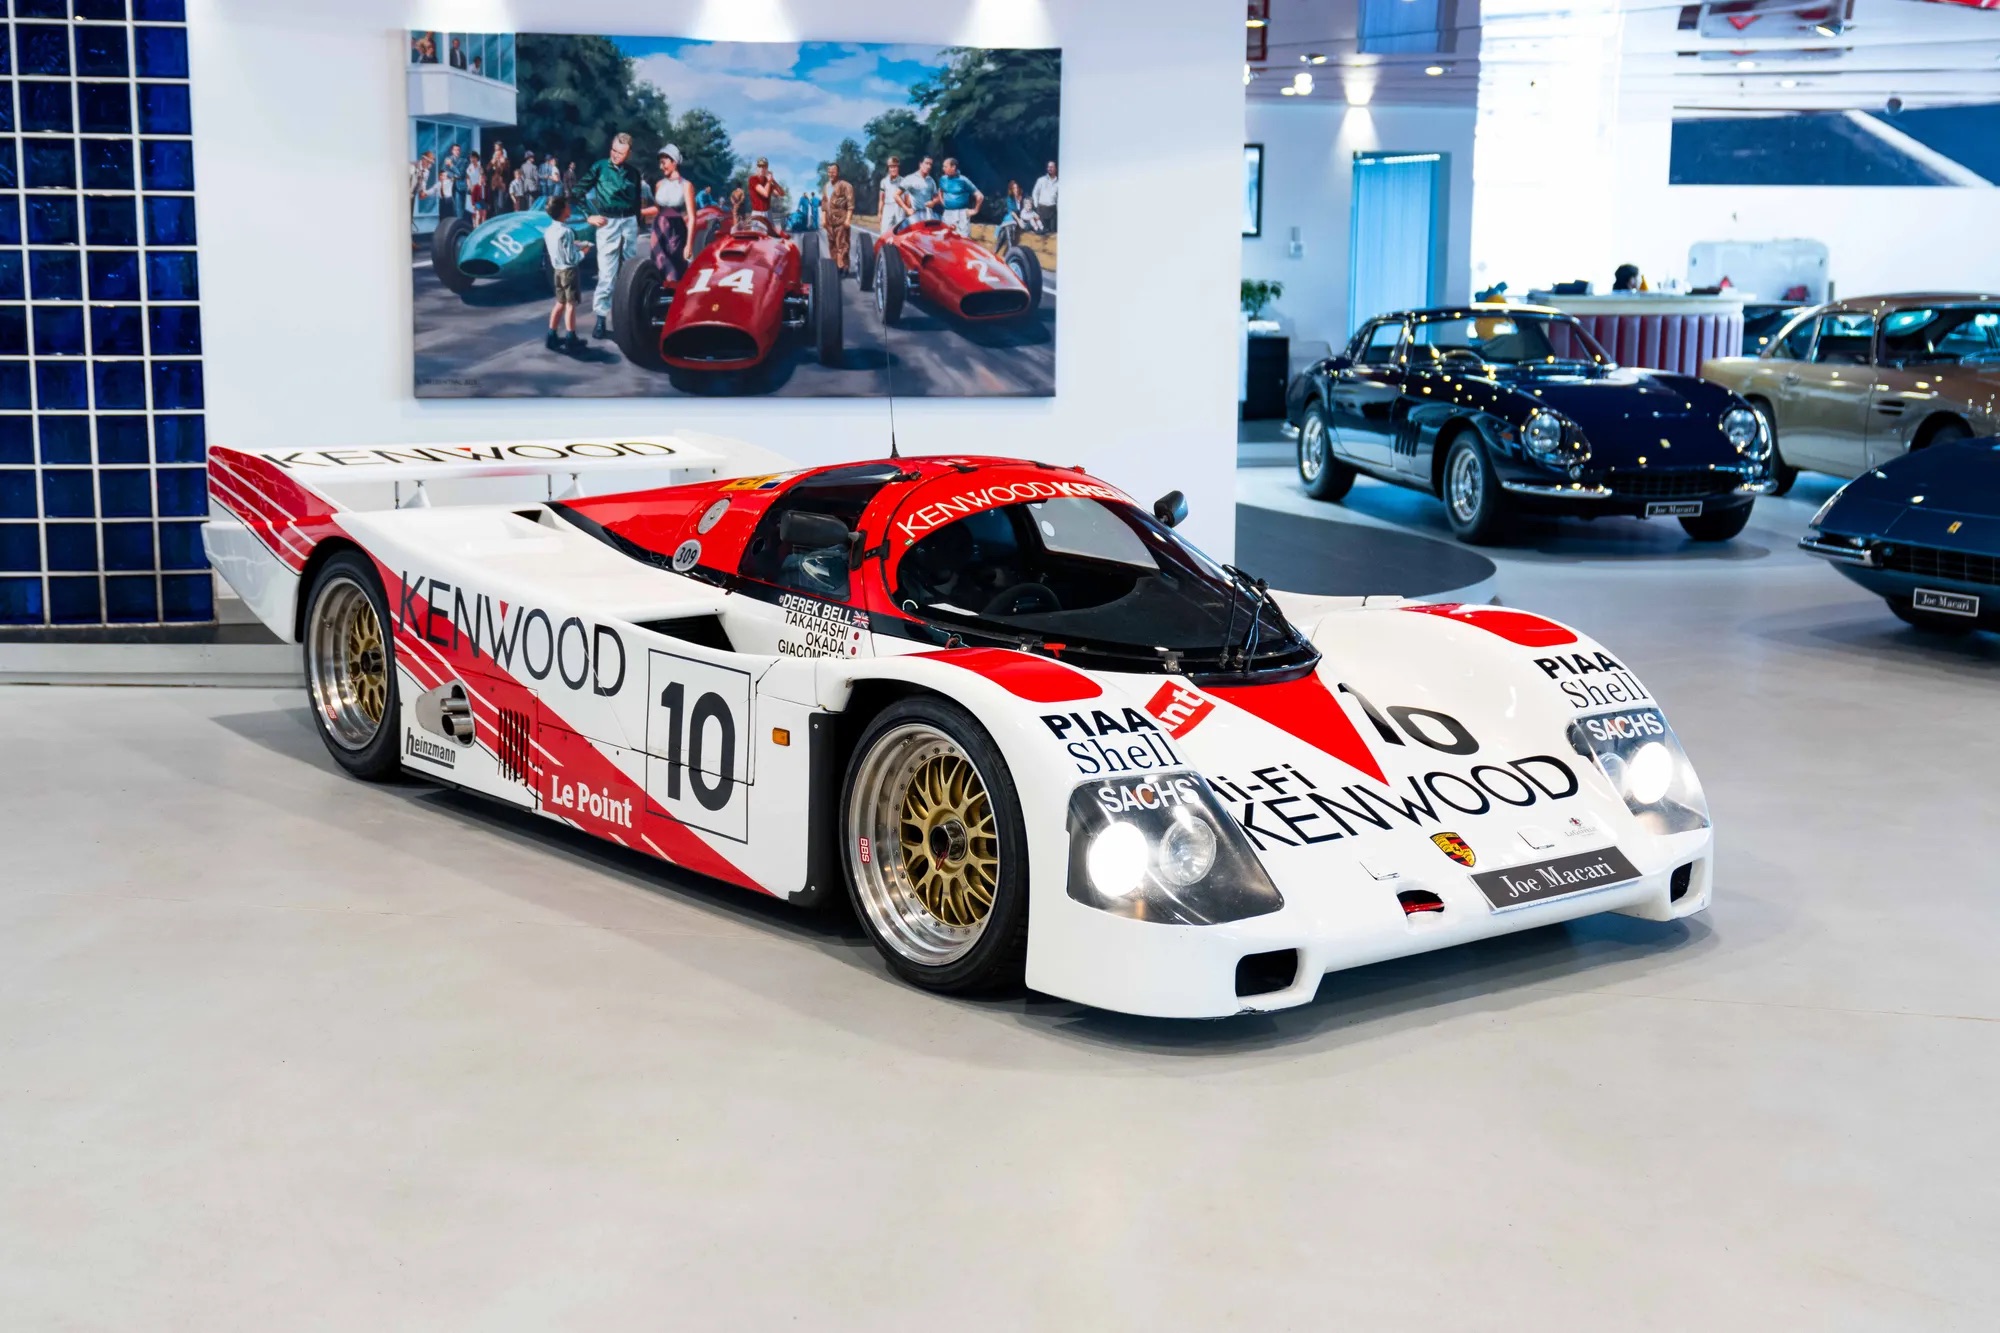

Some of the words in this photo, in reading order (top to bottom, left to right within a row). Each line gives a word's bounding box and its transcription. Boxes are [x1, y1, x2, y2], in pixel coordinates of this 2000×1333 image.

[490, 233, 524, 257] 18
[686, 268, 754, 295] 14
[261, 442, 677, 469] KENWOOD
[897, 482, 1057, 538] KENWOOD
[676, 546, 698, 565] 309
[782, 593, 822, 617] DEREK
[821, 604, 852, 625] BELL
[1921, 593, 1938, 605] Joe
[1939, 596, 1971, 611] Macari
[399, 570, 626, 698] KENWOOD
[784, 610, 849, 641] TAKAHASHI
[805, 632, 845, 656] OKADA
[1533, 651, 1626, 680] PIAA
[1560, 672, 1650, 709] Shell
[1039, 707, 1160, 740] PIAA
[1337, 682, 1480, 756] 10
[1586, 712, 1665, 741] SACHS
[405, 726, 456, 768] heinzmann
[661, 681, 736, 812] 10
[1066, 732, 1183, 775] Shell
[551, 774, 574, 809] Le
[576, 781, 633, 829] Point
[1098, 778, 1200, 813] SACHS
[1230, 754, 1580, 852] KENWOOD
[860, 837, 870, 862] BBS
[1499, 875, 1542, 899] Joe
[1535, 856, 1617, 889] Macari
